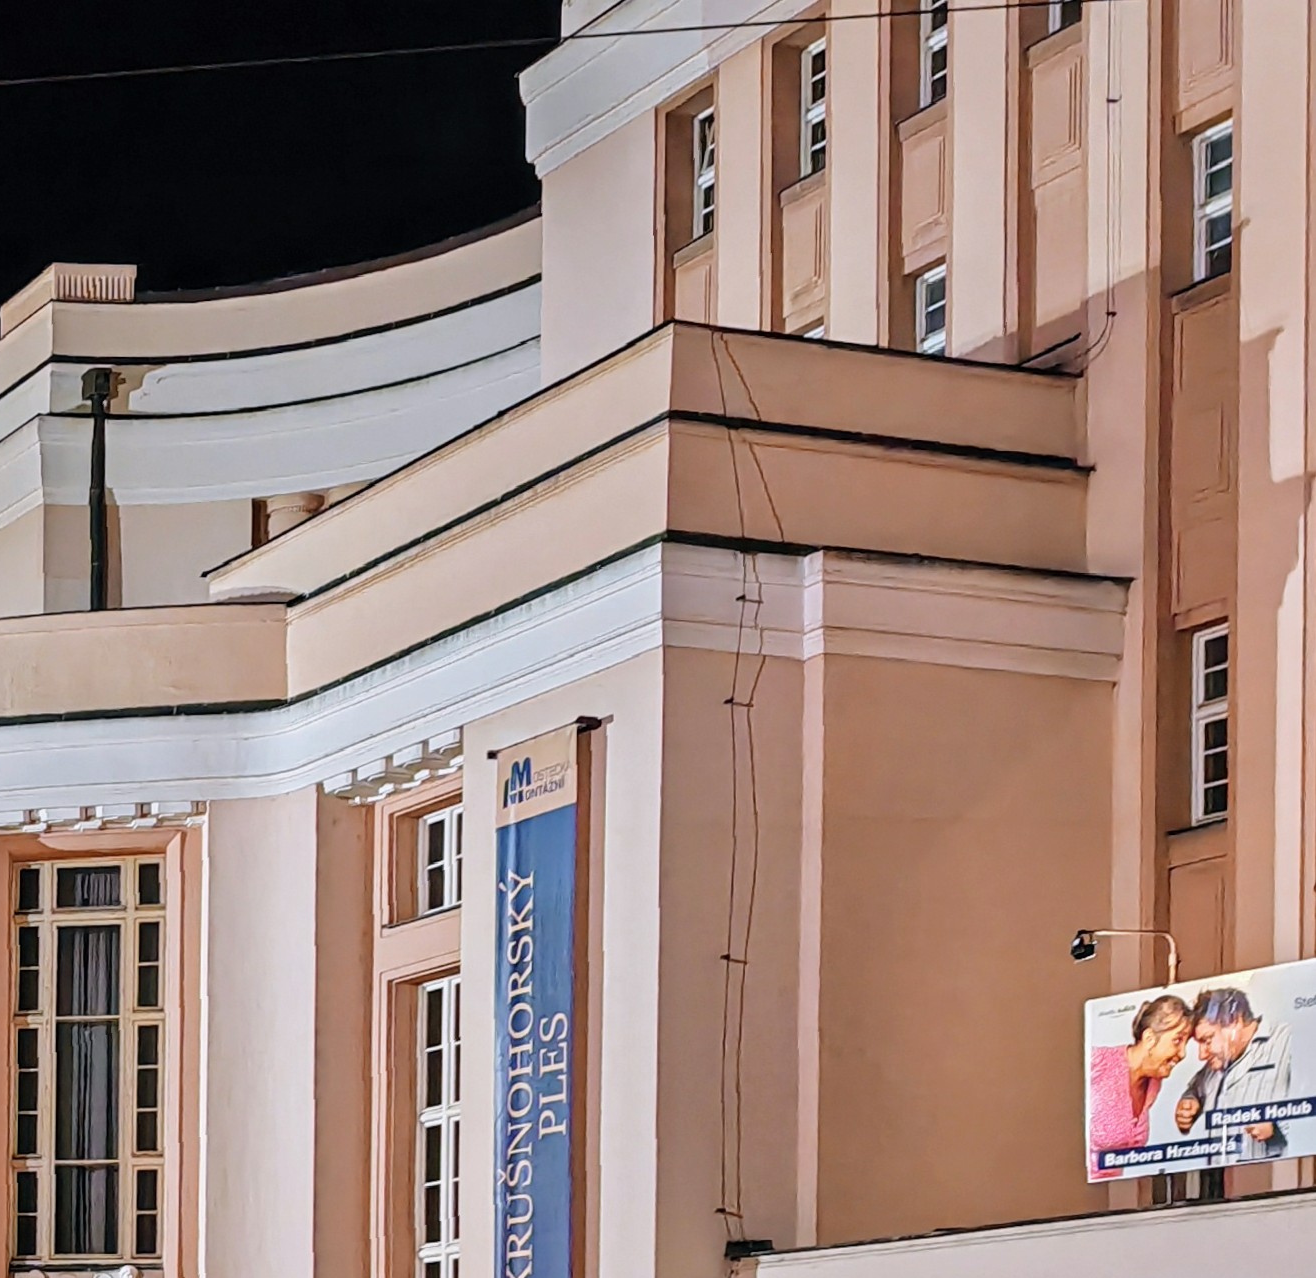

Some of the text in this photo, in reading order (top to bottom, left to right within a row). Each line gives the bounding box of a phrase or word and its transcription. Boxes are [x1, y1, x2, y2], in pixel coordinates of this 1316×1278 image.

[538, 1012, 569, 1140] PLES
[1211, 1100, 1313, 1127] Radek Holub
[1104, 1148, 1163, 1167] Barbora
